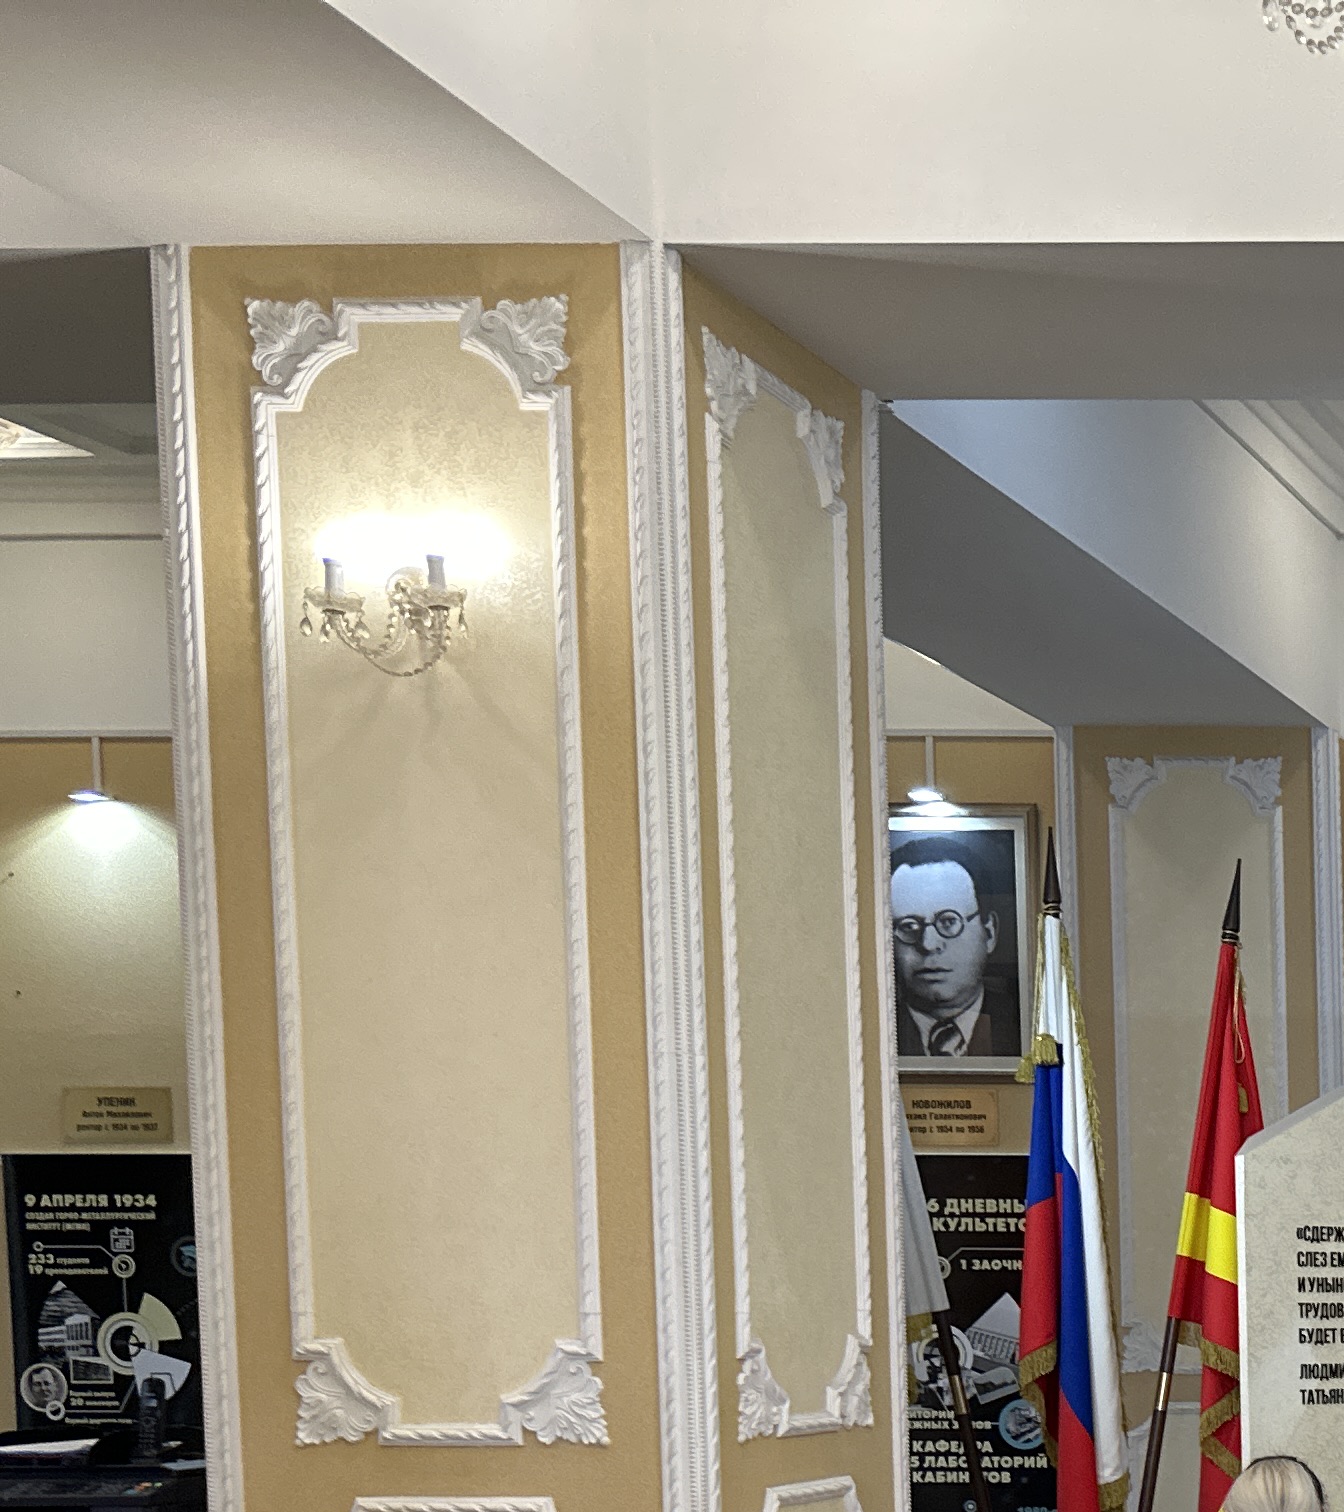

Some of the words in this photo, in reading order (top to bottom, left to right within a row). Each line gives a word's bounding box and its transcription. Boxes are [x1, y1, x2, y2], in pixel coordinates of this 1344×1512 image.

[24, 1193, 37, 1207] 9
[40, 1193, 109, 1208] АПРЕЛЯ
[114, 1193, 157, 1208] 1934
[971, 1259, 1023, 1271] ЗАОЧН
[1296, 1251, 1328, 1268] СЛЕЗ
[1297, 1277, 1306, 1294] И
[1299, 1327, 1337, 1345] БУДЕТ
[923, 1453, 1048, 1468] ЛАБОАТОРИЙ
[912, 1471, 1011, 1484] КАБИНТОВ
